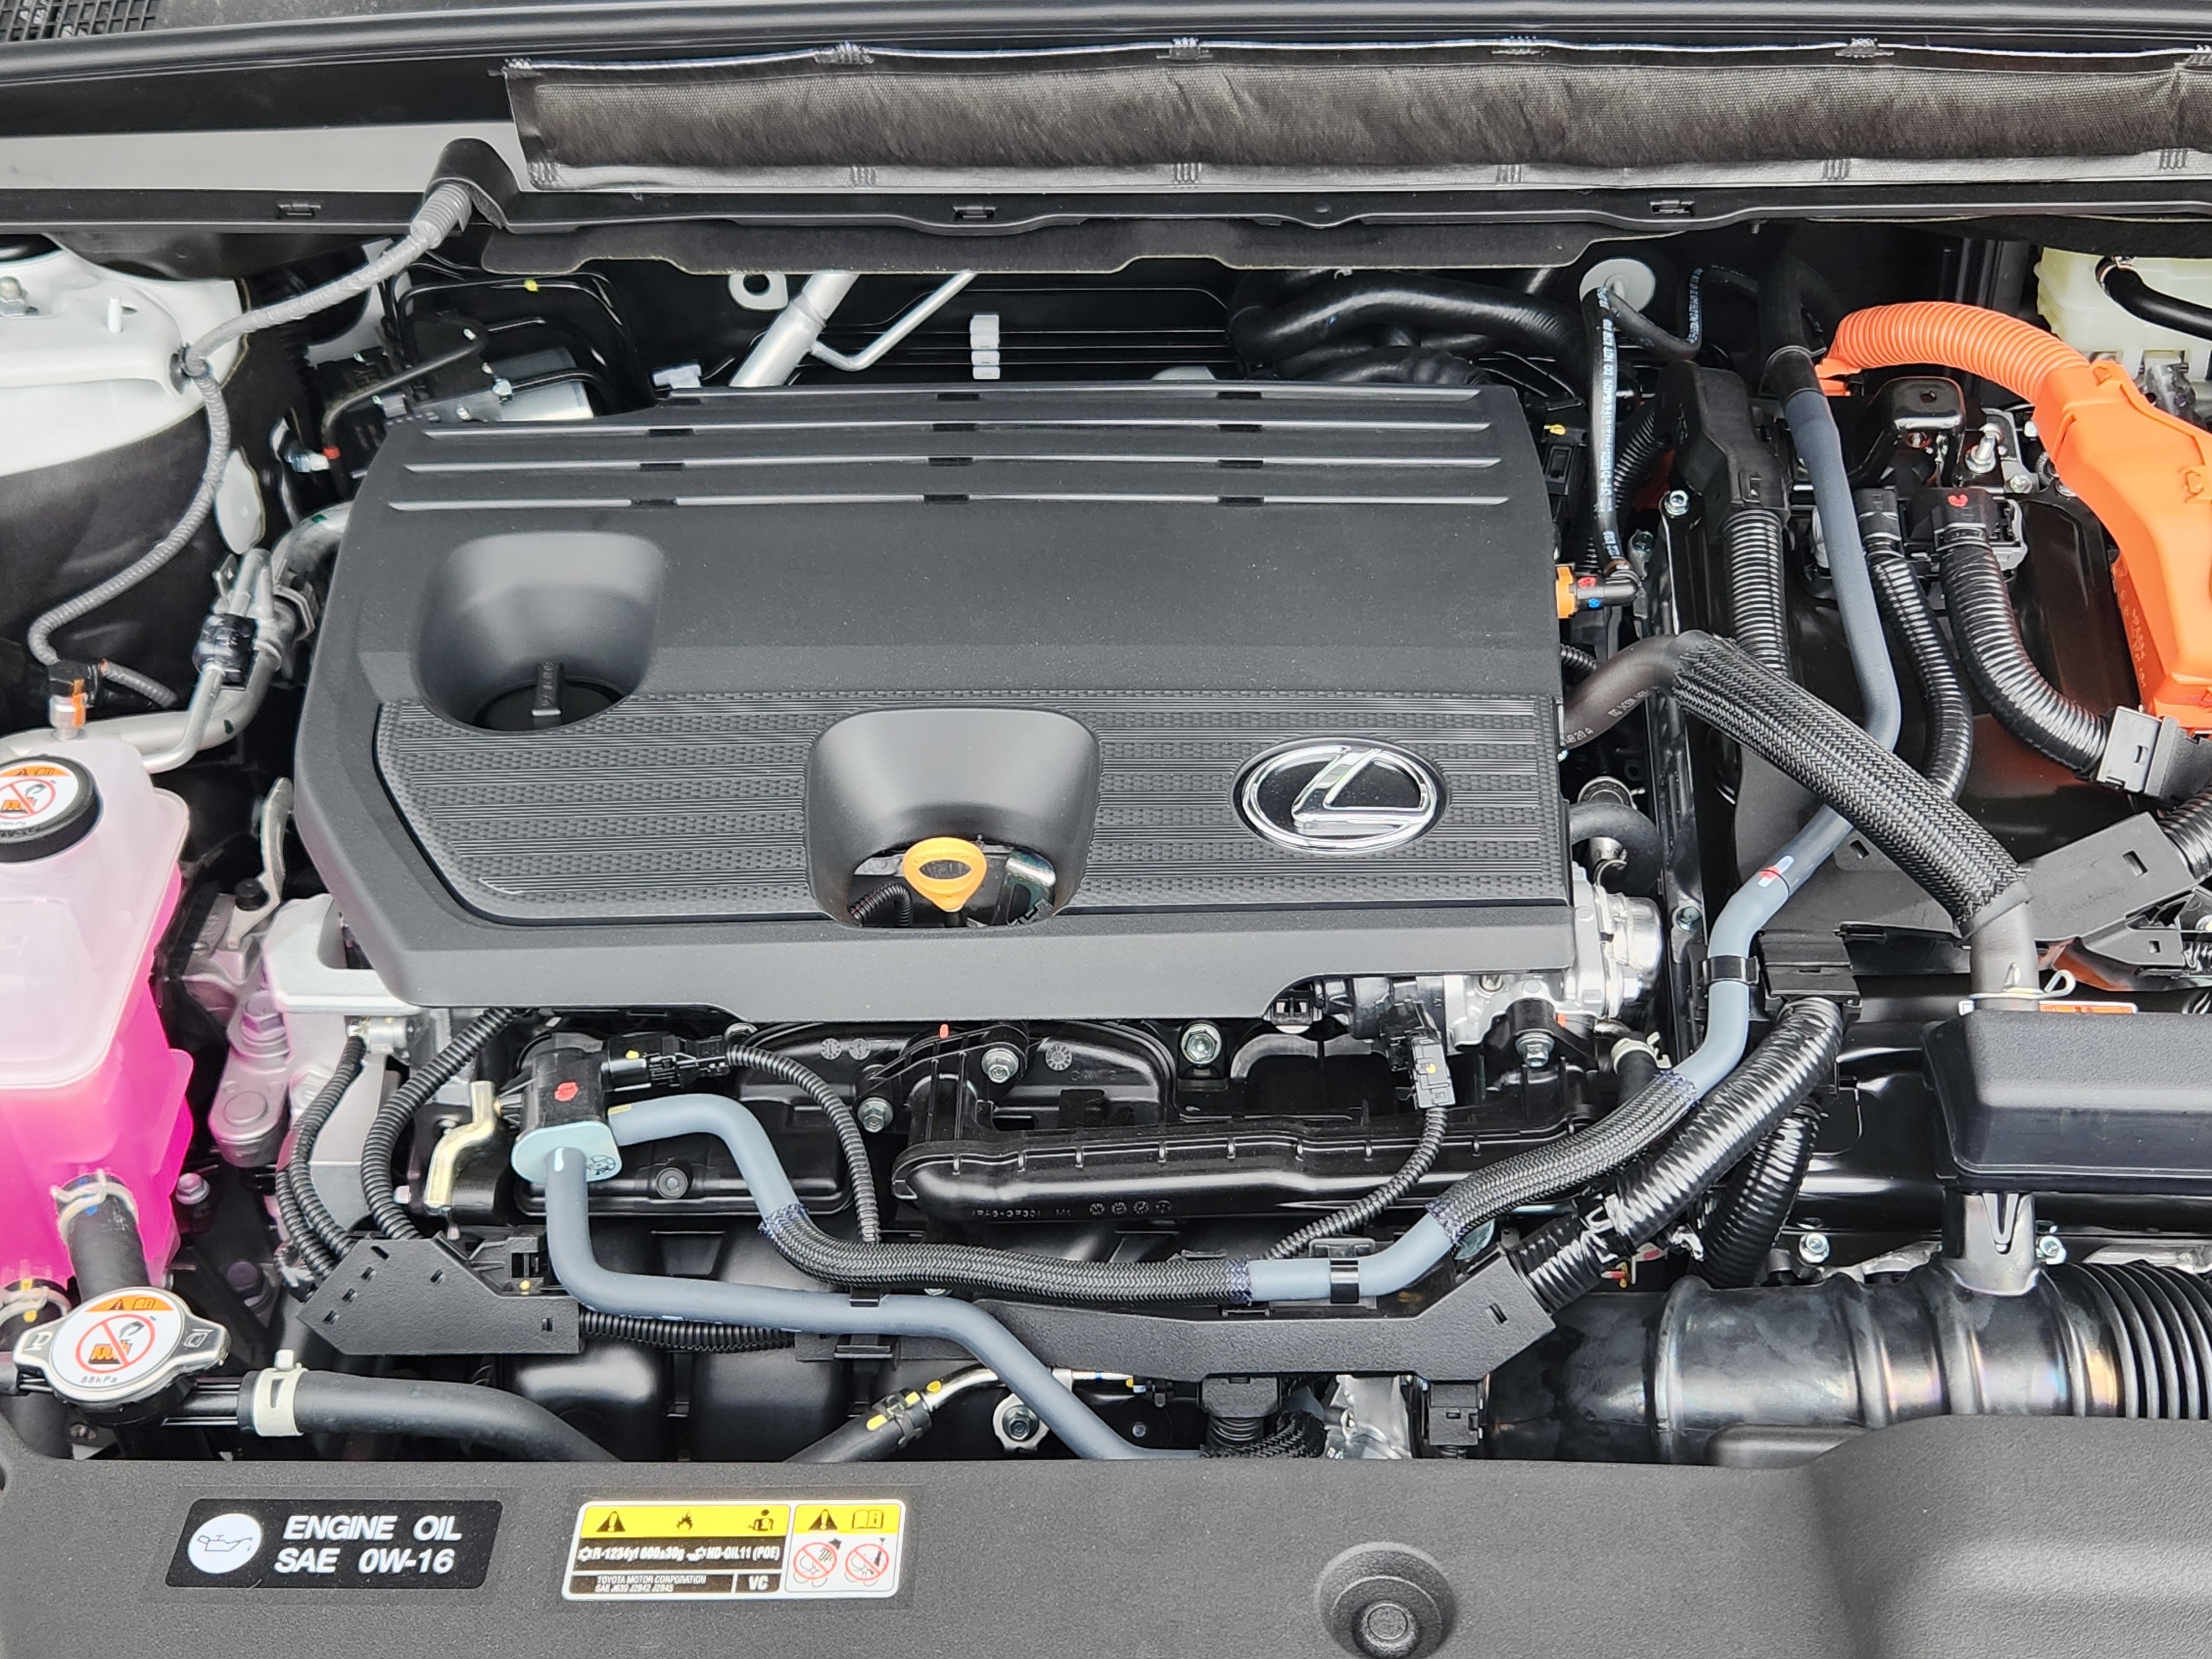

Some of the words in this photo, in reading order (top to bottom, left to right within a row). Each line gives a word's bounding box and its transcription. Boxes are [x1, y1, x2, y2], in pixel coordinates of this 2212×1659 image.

[80, 1375, 118, 1384] 88kPa
[283, 1515, 398, 1541] ENGINE
[413, 1515, 462, 1541] OIL
[273, 1547, 340, 1574] SAE
[358, 1548, 455, 1574] 0W-16
[753, 1546, 780, 1561] (POE)
[597, 1575, 625, 1584] TOYOTA
[627, 1575, 654, 1584] MOTOR
[654, 1575, 707, 1584] CORPORATION
[748, 1575, 769, 1591] VC
